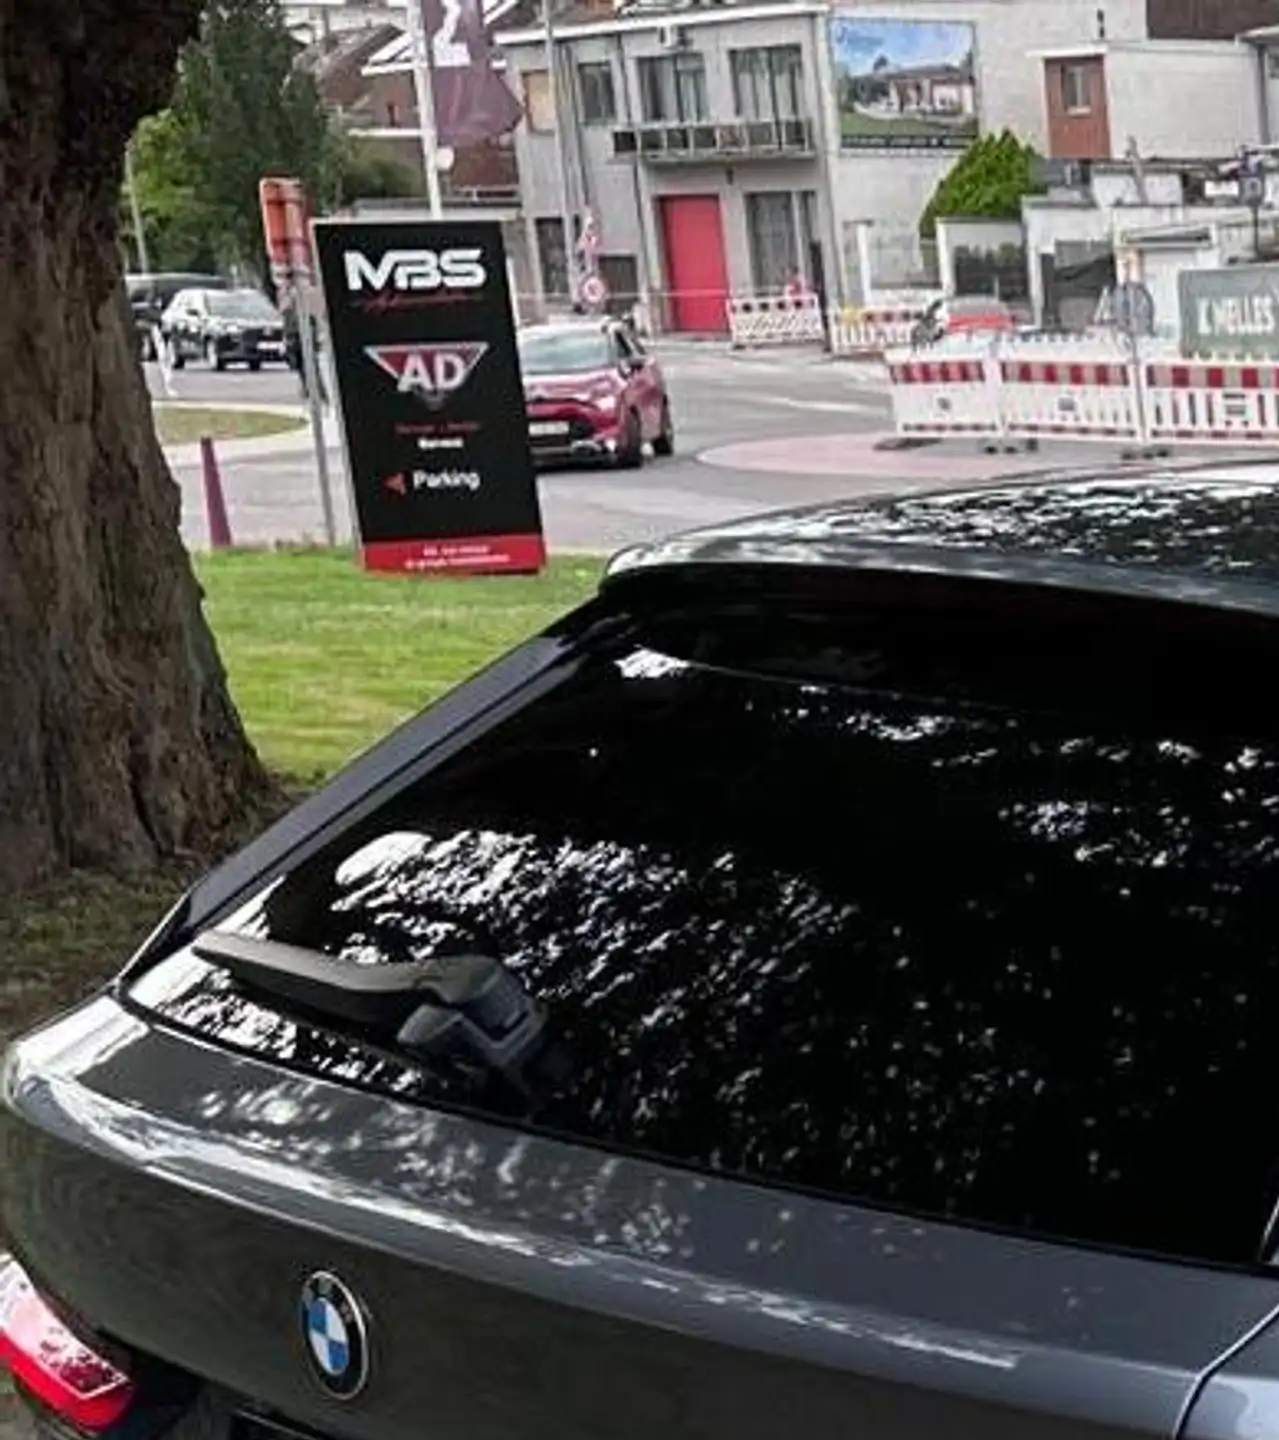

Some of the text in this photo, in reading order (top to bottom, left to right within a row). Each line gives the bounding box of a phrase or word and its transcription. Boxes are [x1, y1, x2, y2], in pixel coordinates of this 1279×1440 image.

[344, 249, 487, 291] MBS
[397, 351, 467, 393] AD
[413, 469, 481, 491] Parking
